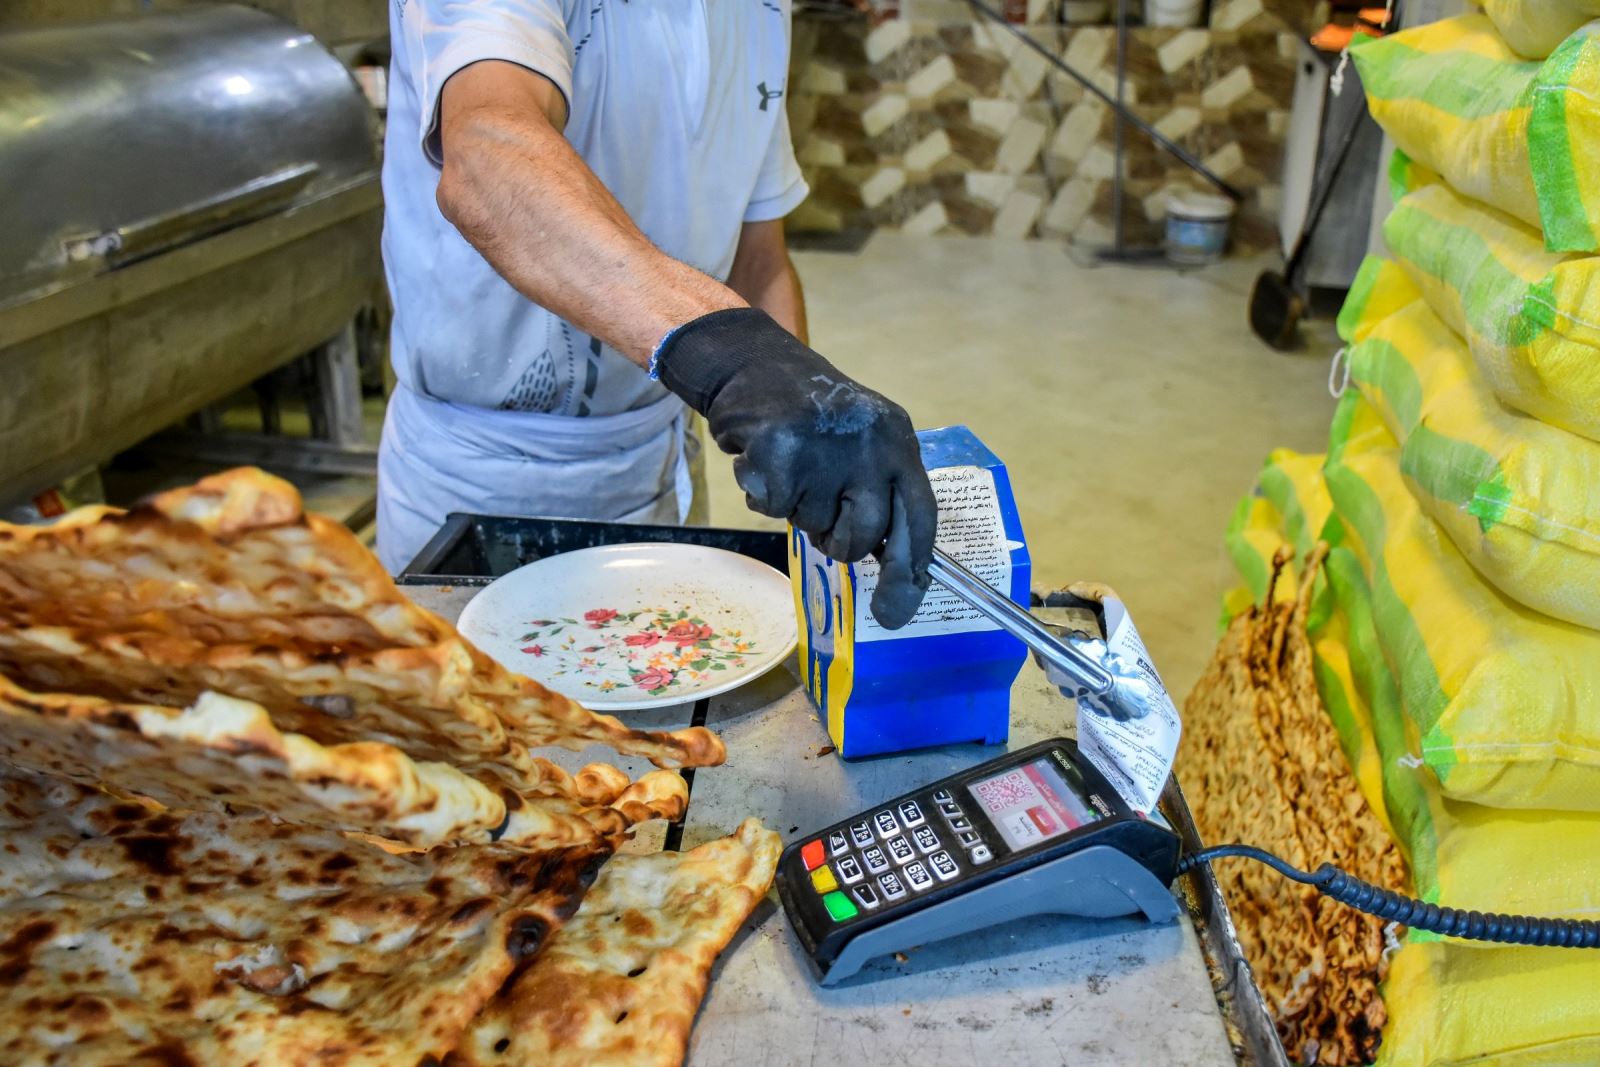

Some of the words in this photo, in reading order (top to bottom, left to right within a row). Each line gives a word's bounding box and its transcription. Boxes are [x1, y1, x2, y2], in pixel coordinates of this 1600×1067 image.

[954, 486, 968, 495] گرامی
[1052, 750, 1070, 770] Desk/3500
[1090, 795, 1111, 817] ingenico
[917, 830, 930, 838] 2
[892, 840, 905, 848] 5
[867, 849, 880, 858] 8
[934, 855, 947, 863] 3
[908, 864, 920, 873] 6
[881, 875, 895, 884] 9
